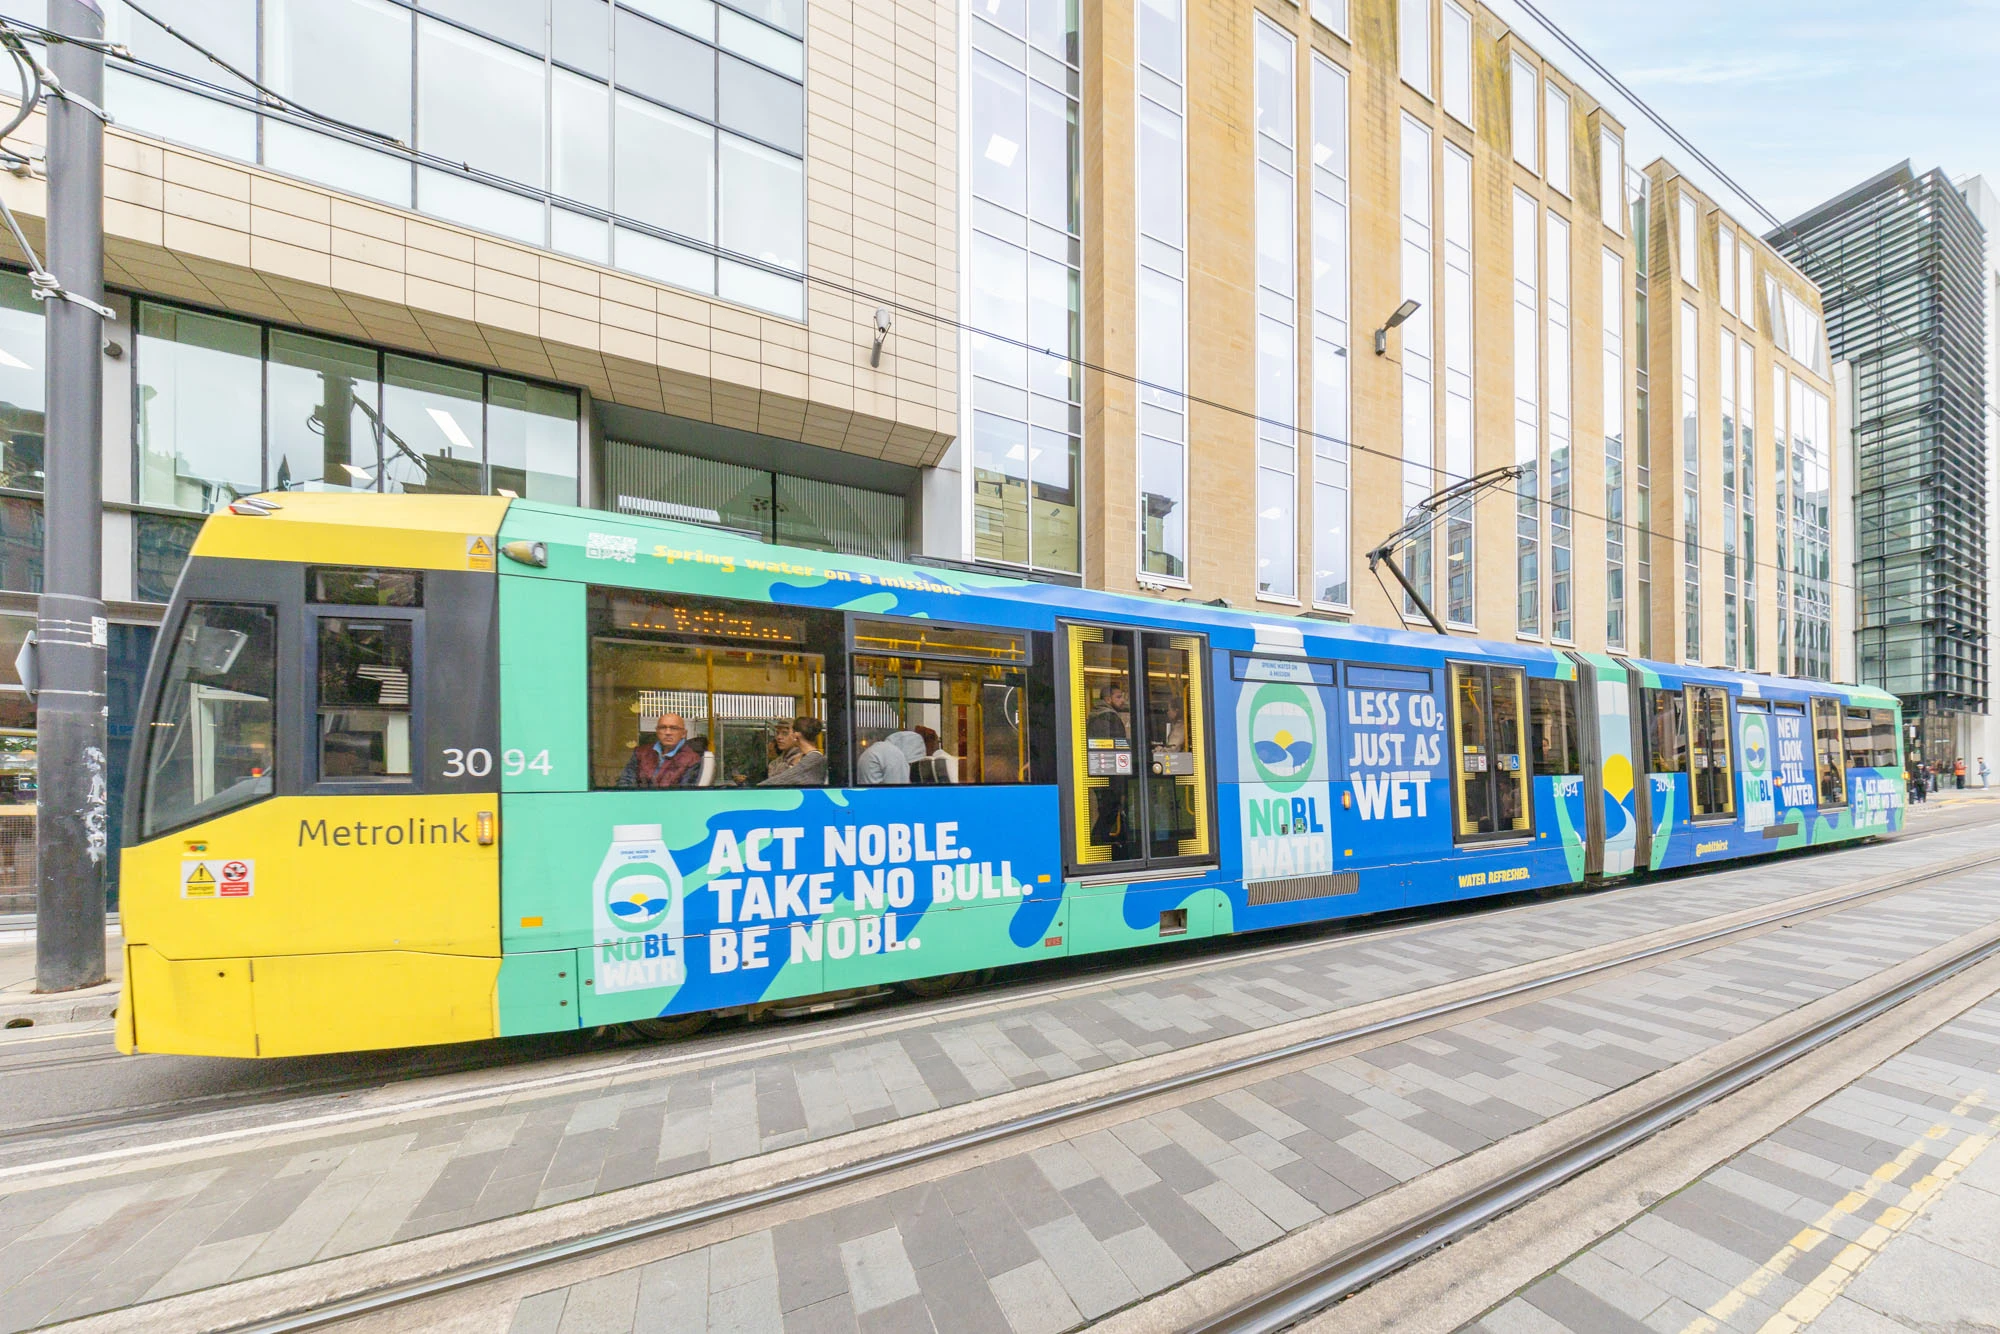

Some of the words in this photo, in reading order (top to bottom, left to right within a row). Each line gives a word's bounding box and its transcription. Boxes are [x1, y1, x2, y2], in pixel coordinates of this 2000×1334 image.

[652, 544, 735, 573] Spring
[744, 558, 816, 577] water
[823, 569, 851, 582] on
[859, 573, 873, 585] a
[879, 576, 960, 596] mission.
[1347, 690, 1400, 726] LESS
[1777, 717, 1800, 738] NEW
[1349, 733, 1405, 767] JUST
[1413, 733, 1441, 766] AS
[1778, 740, 1804, 761] LOOK
[1655, 779, 1675, 792] 3094
[1780, 762, 1806, 784] STILL
[1350, 770, 1431, 821] WET
[1552, 782, 1579, 797] 3094
[1745, 779, 1771, 802] NOBL
[1782, 784, 1814, 807] WATER
[298, 817, 471, 847] Metrolink
[1249, 796, 1324, 837] NOBL
[706, 827, 805, 874] ACT
[823, 821, 972, 868] NOBLE.
[1249, 836, 1326, 878] WATR
[707, 872, 834, 924] TAKE
[853, 867, 915, 911] NO
[931, 860, 1034, 904] BULL.
[1458, 870, 1486, 888] WATER
[1488, 867, 1530, 885] REFRESHED.
[602, 932, 676, 963] NOBL
[709, 924, 770, 974] BE
[789, 912, 922, 965] NOBL.
[602, 958, 678, 989] WATR
